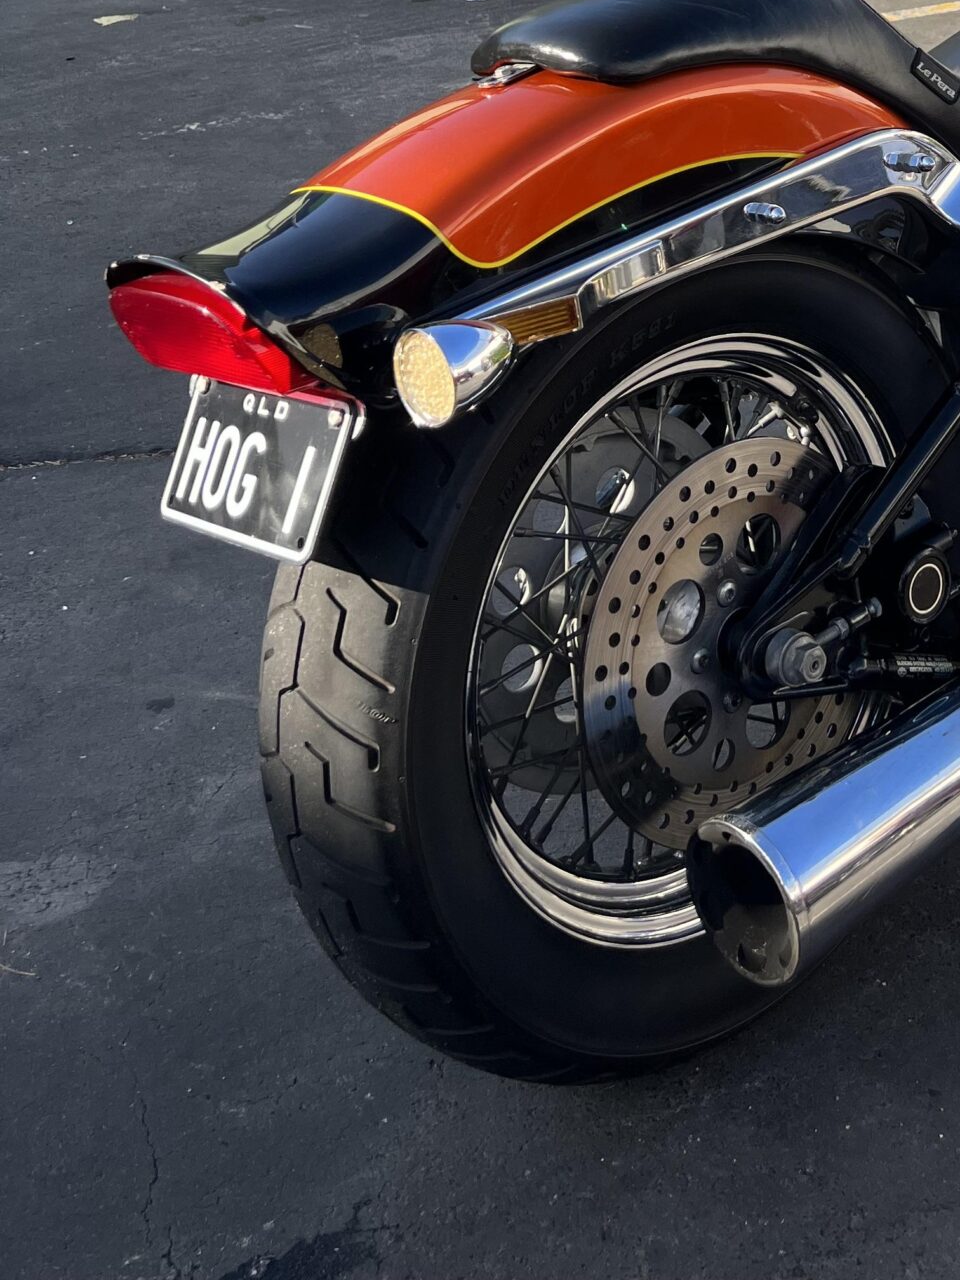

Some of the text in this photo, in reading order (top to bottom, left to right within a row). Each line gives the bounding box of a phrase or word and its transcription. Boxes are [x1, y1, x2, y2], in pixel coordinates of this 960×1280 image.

[916, 61, 956, 99] Le Pera
[243, 393, 290, 421] QLD
[175, 416, 268, 519] HOG
